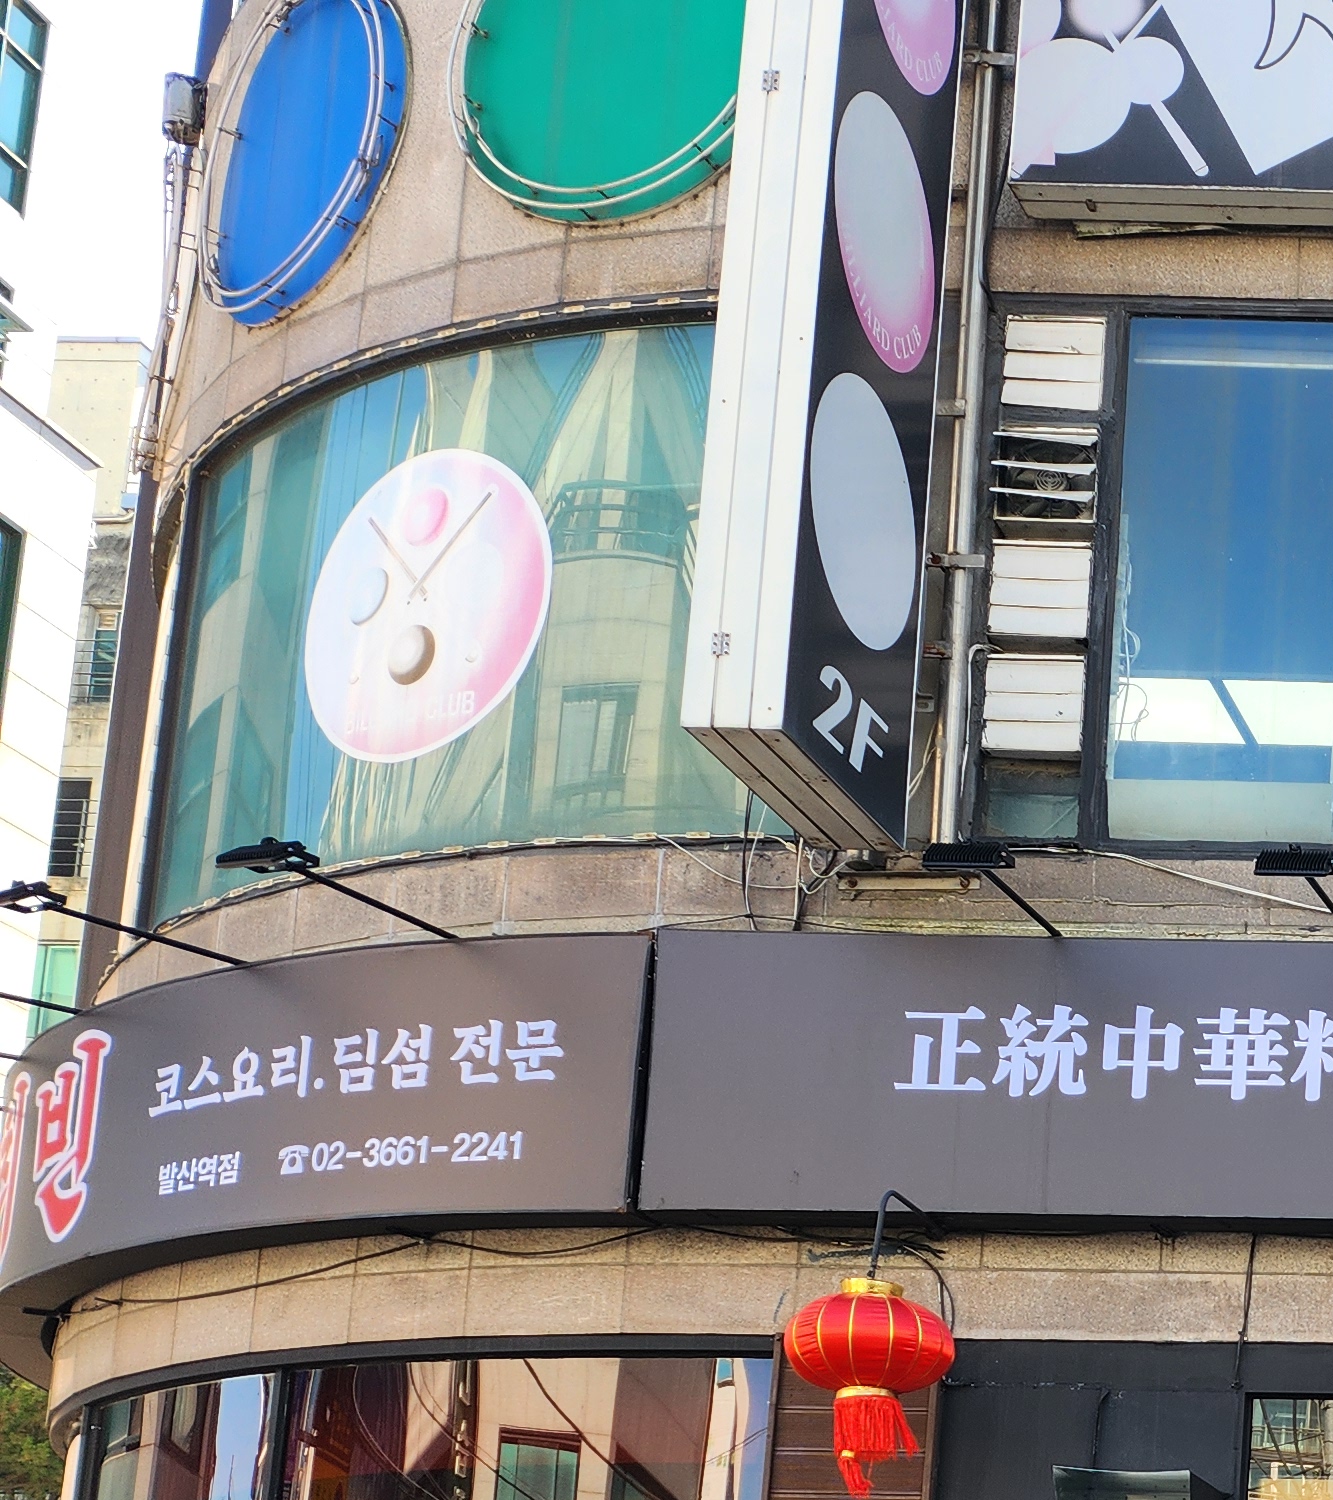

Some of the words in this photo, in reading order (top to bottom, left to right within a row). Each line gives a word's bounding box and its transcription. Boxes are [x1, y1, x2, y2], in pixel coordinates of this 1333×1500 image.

[916, 51, 944, 82] CLUB
[893, 323, 922, 360] CLUB
[426, 690, 475, 719] CLUB
[812, 664, 891, 774] 2F
[449, 1019, 565, 1086] 전문
[157, 1150, 241, 1196] 발산역점
[311, 1129, 524, 1173] 02-3661-2241
